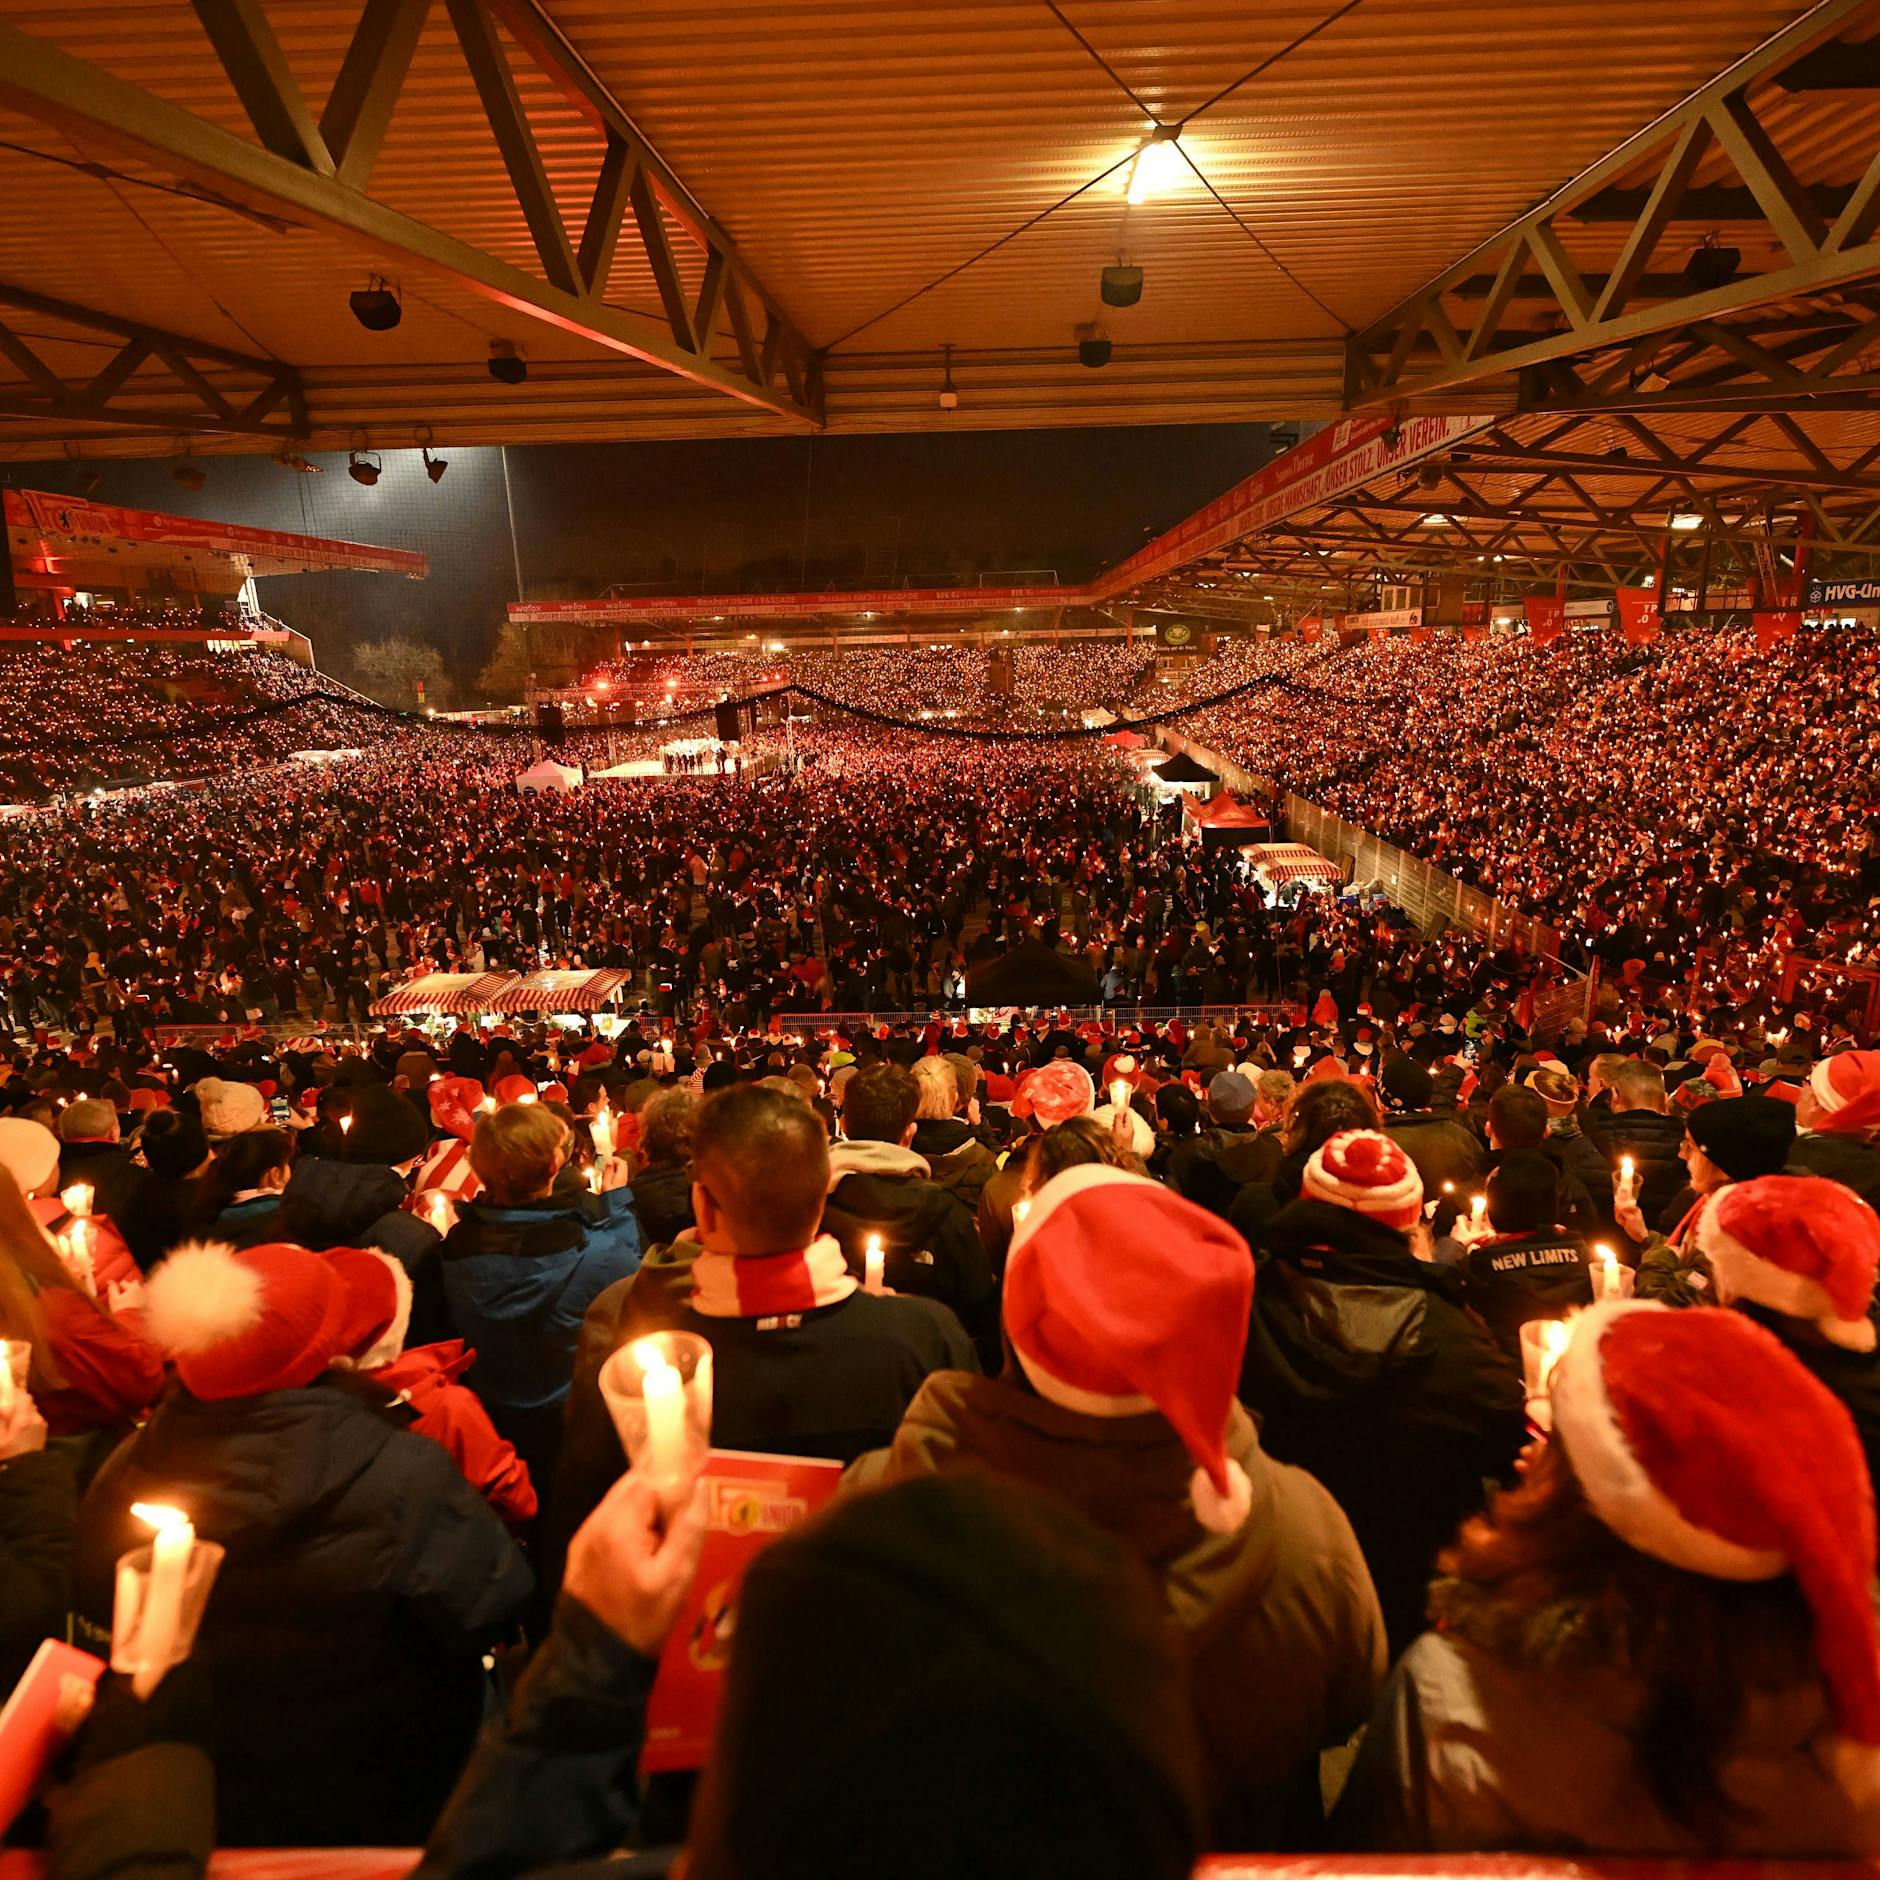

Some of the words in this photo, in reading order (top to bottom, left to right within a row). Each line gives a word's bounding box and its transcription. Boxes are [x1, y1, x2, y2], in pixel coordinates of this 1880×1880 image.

[1326, 459, 1349, 493] UNSER
[1350, 446, 1375, 480] STOLZ.
[1409, 416, 1450, 453] VEREIN.
[1491, 1251, 1527, 1271] NEW
[1528, 1248, 1579, 1265] LIMITS
